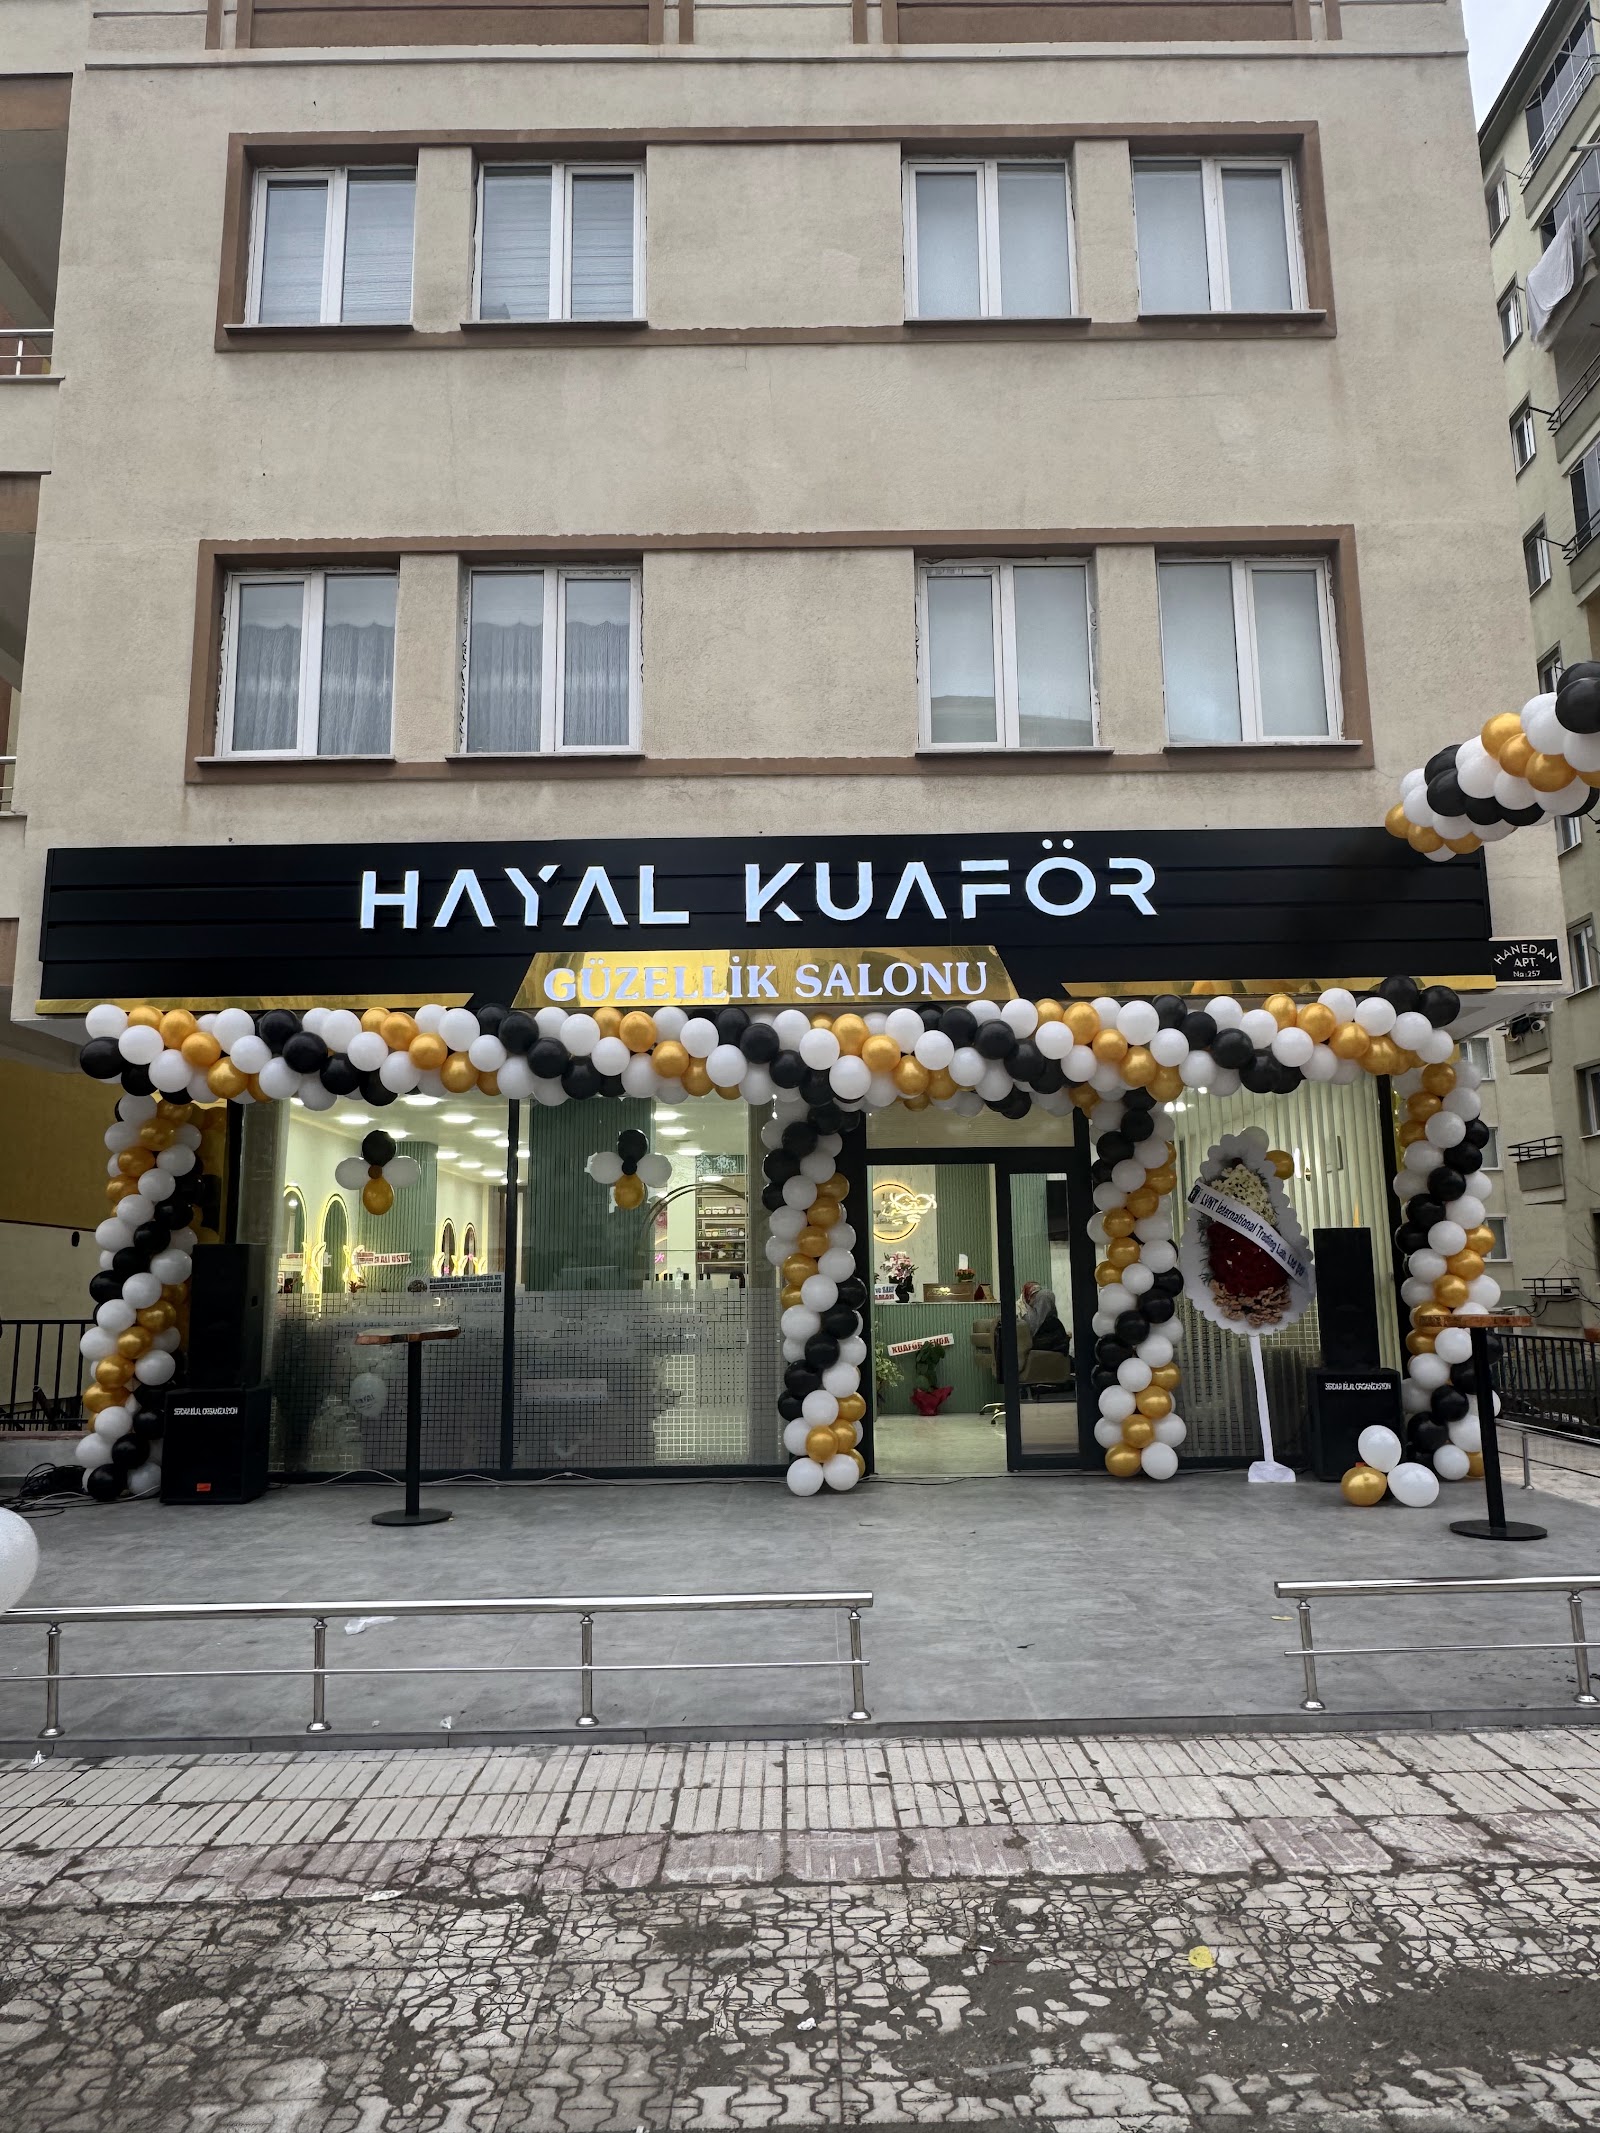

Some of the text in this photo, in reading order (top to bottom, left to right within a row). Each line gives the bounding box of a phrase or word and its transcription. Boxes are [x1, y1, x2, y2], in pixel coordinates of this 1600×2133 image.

[360, 838, 1159, 929] HAYAL KUAFÖR
[1493, 944, 1558, 965] HANEDAN
[1514, 957, 1539, 967] APT.
[543, 956, 988, 1002] GÜZELLİK SALONU
[1255, 1224, 1277, 1253] Trading
